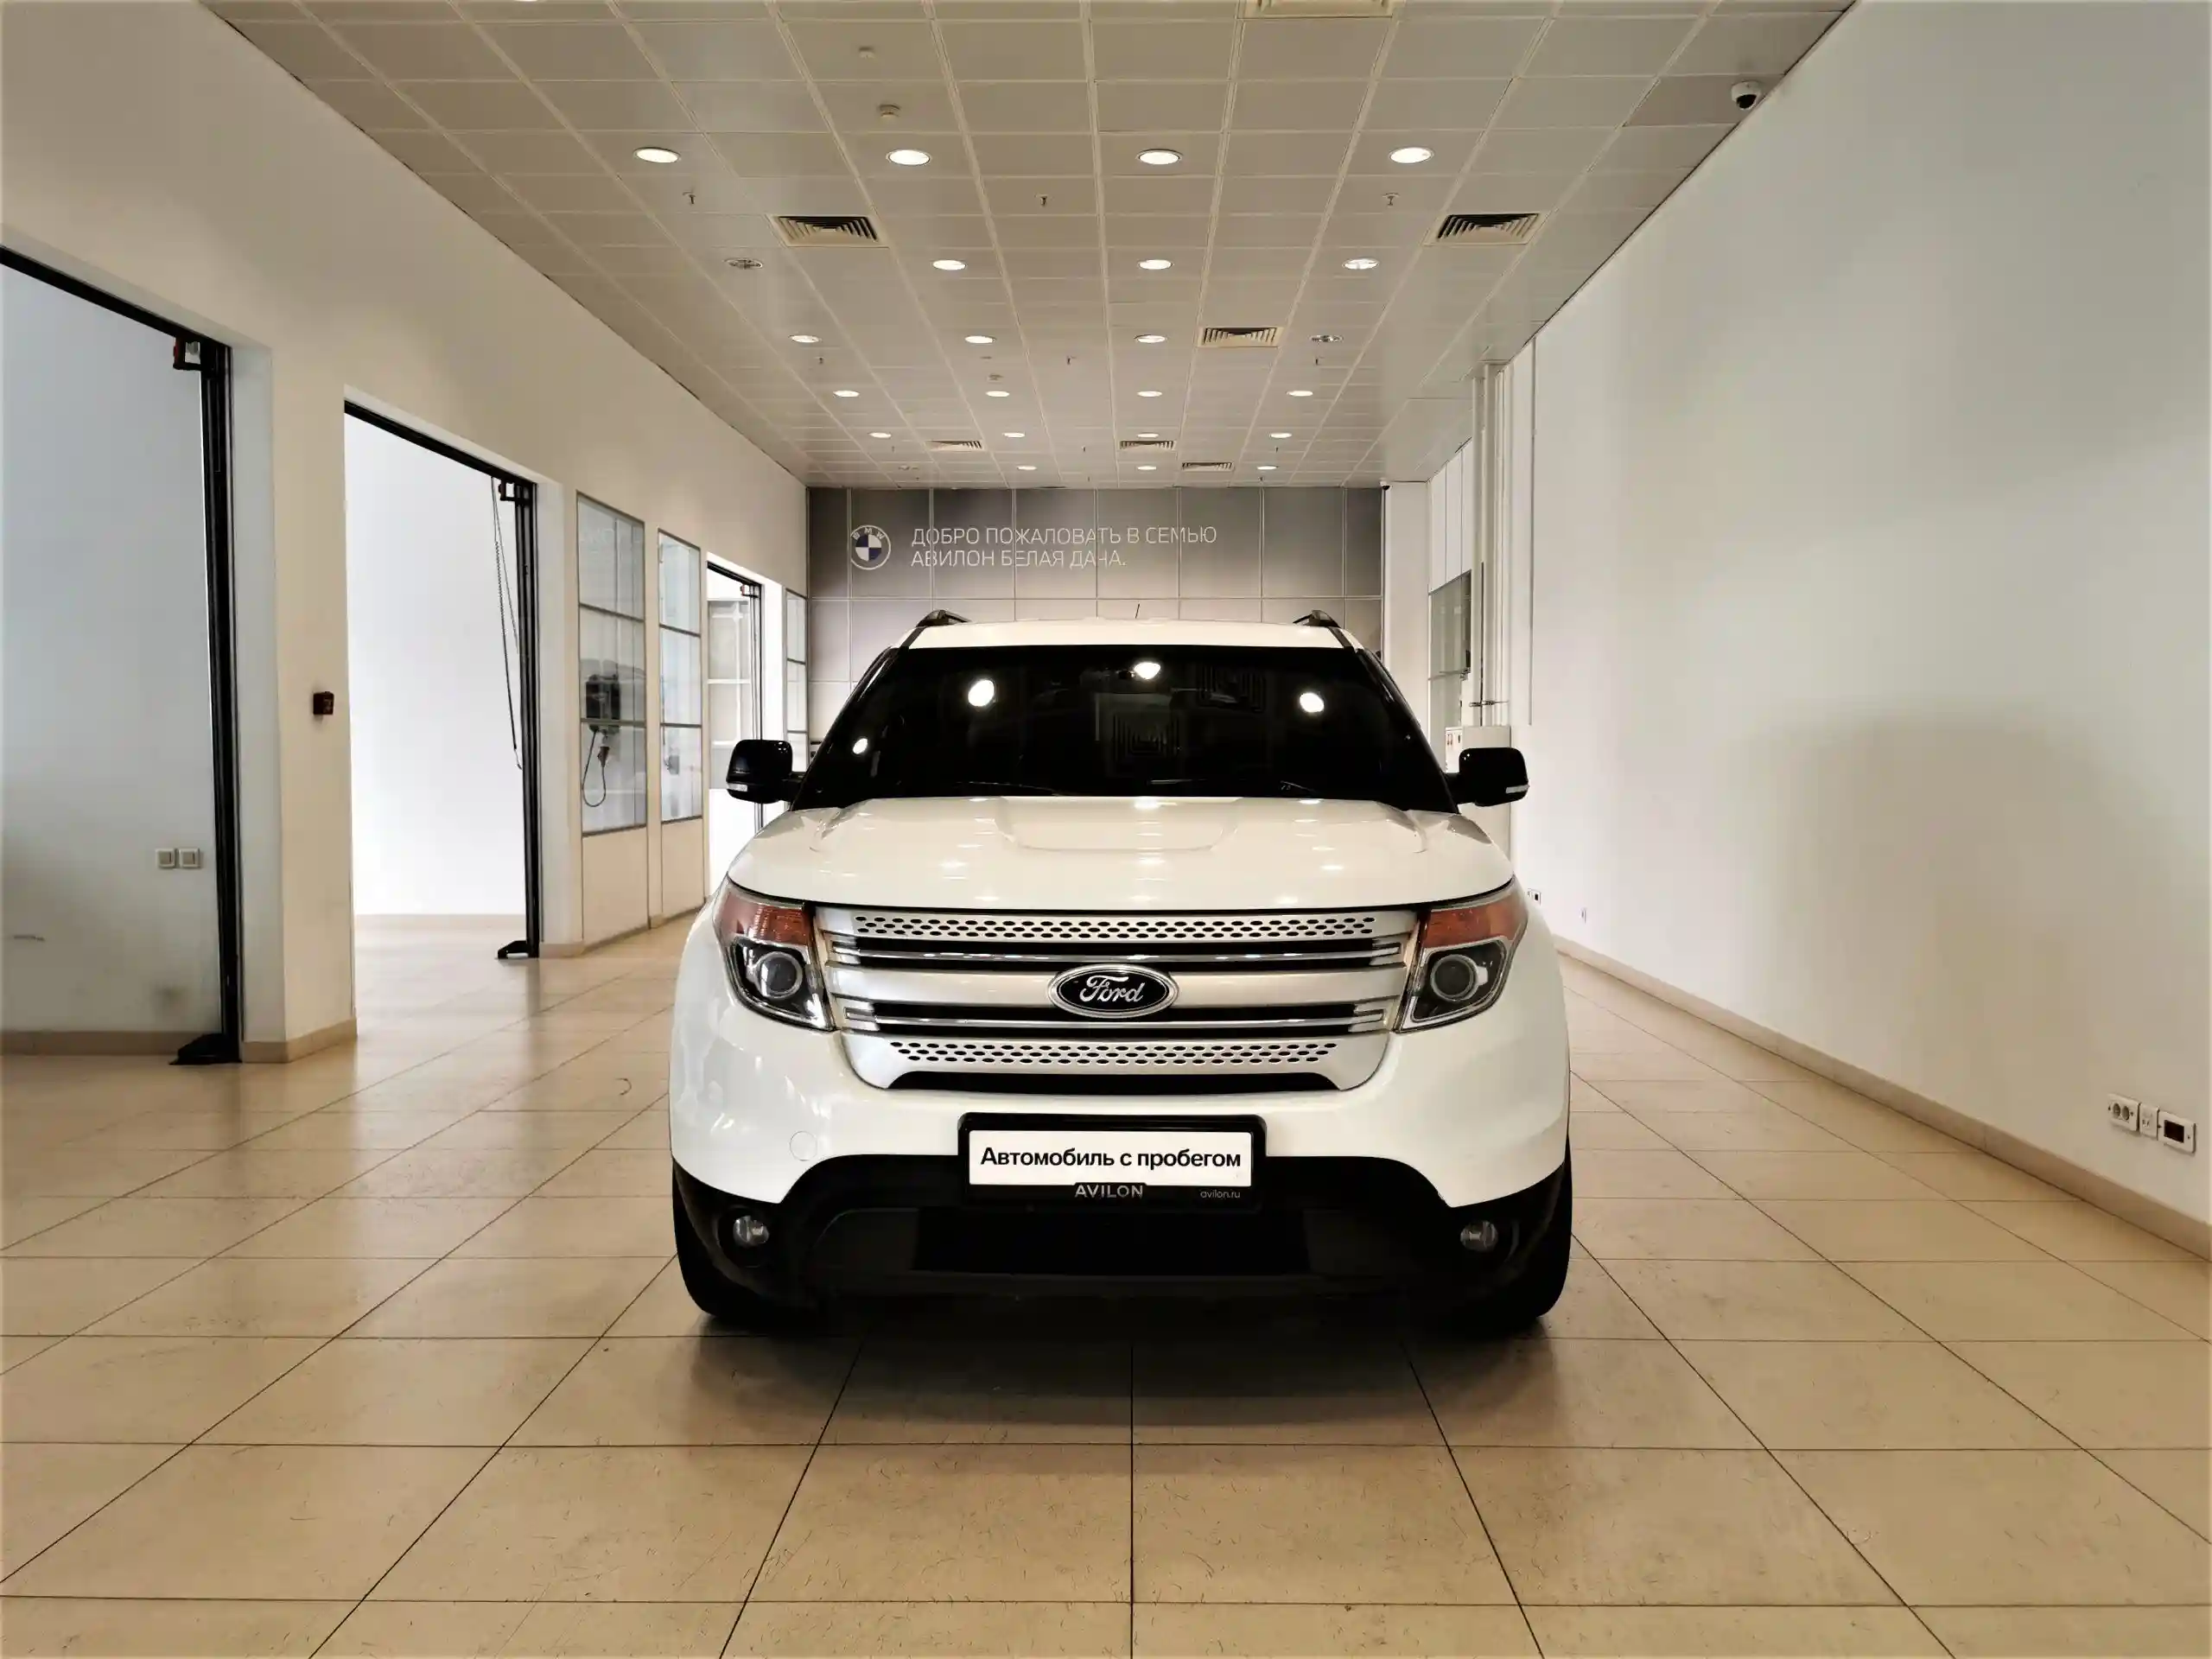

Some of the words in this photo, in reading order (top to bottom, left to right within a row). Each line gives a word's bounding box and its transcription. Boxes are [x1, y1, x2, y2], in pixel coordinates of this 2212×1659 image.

[852, 527, 887, 541] BMW
[911, 528, 980, 547] ДОБРО
[986, 527, 1122, 545] ПОЖАЛОВАТЬ
[1127, 527, 1140, 543] В
[1146, 526, 1217, 543] СЕМЬЮ
[911, 550, 995, 567] АВИЛОН
[1001, 550, 1065, 568] БЕЛАЯ
[1079, 975, 1146, 1002] Ford
[980, 1147, 1115, 1166] Автомобиль
[1120, 1153, 1133, 1166] с
[1137, 1148, 1241, 1171] пробегом
[1074, 1185, 1143, 1198] AVILON
[1200, 1189, 1241, 1199] avilon.ru
